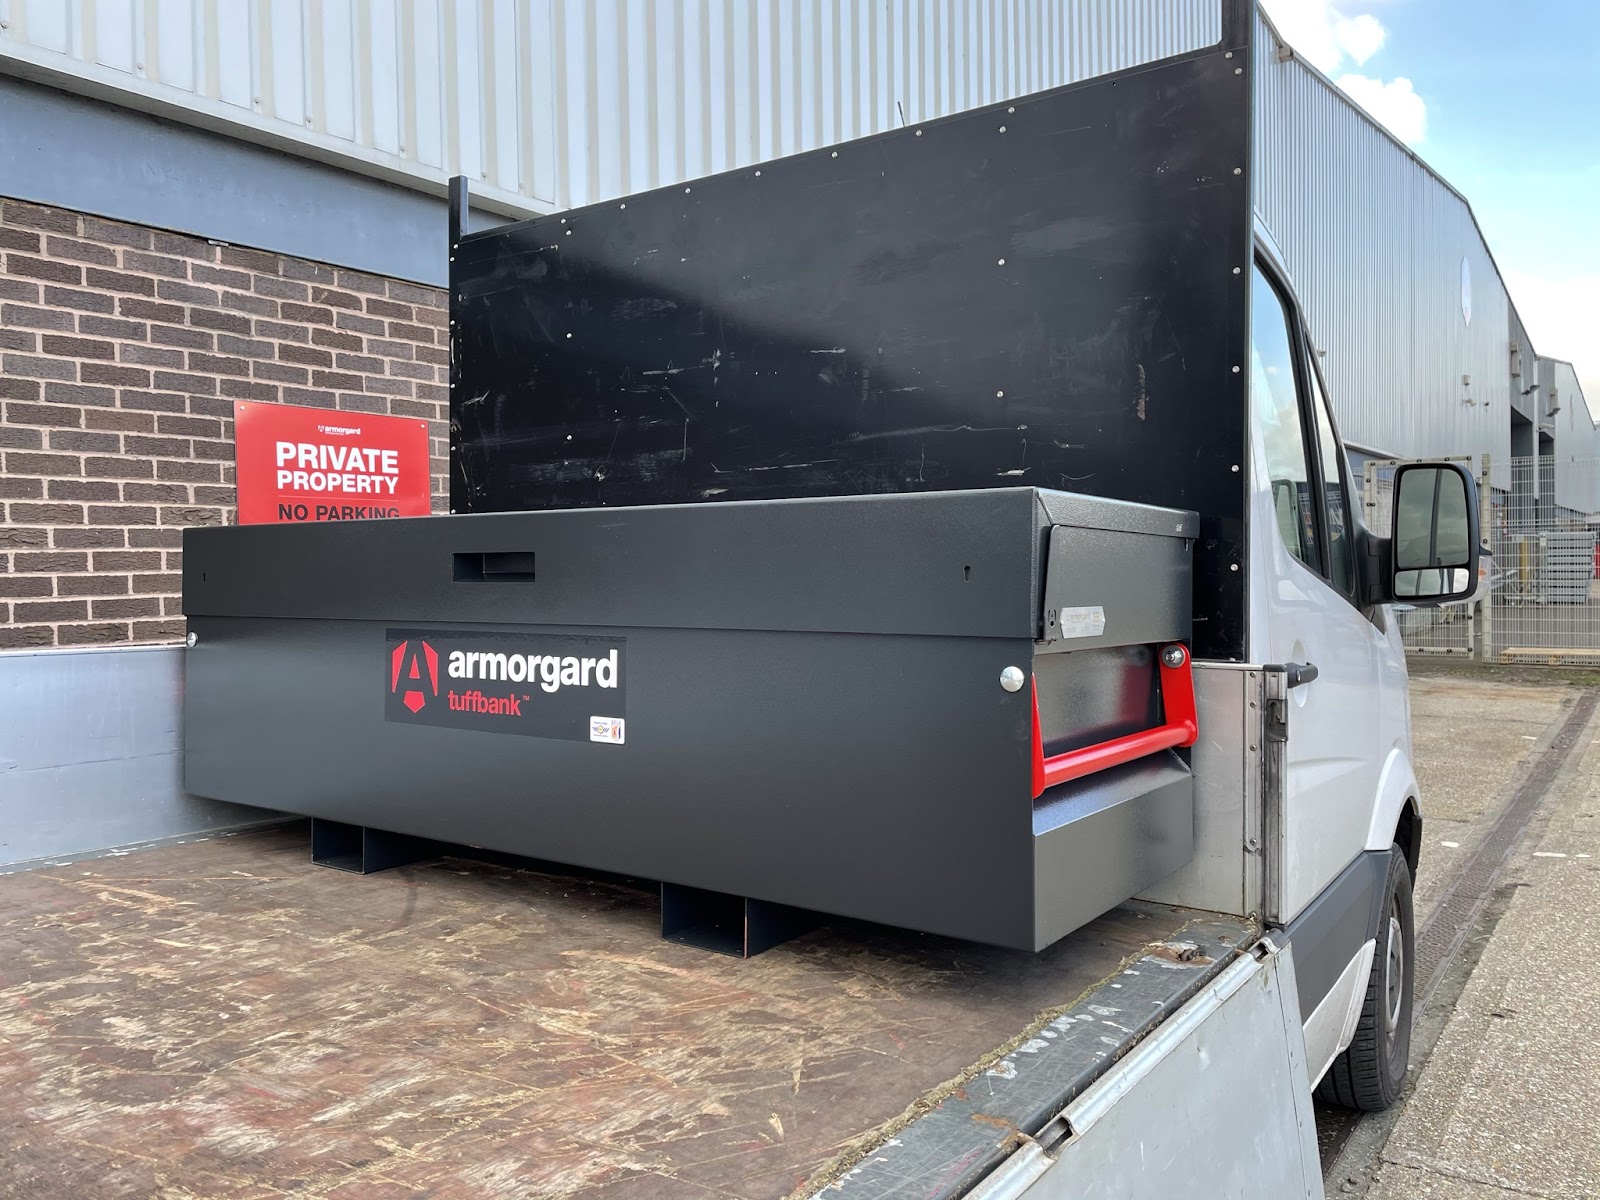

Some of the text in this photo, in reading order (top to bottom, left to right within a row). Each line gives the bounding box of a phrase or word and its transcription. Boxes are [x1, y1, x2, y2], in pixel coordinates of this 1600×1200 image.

[324, 425, 361, 435] armorgard
[276, 441, 399, 475] PRIVATE
[277, 470, 399, 495] PROPERTY
[278, 503, 400, 521] NO PARKING
[448, 649, 618, 693] armorgard
